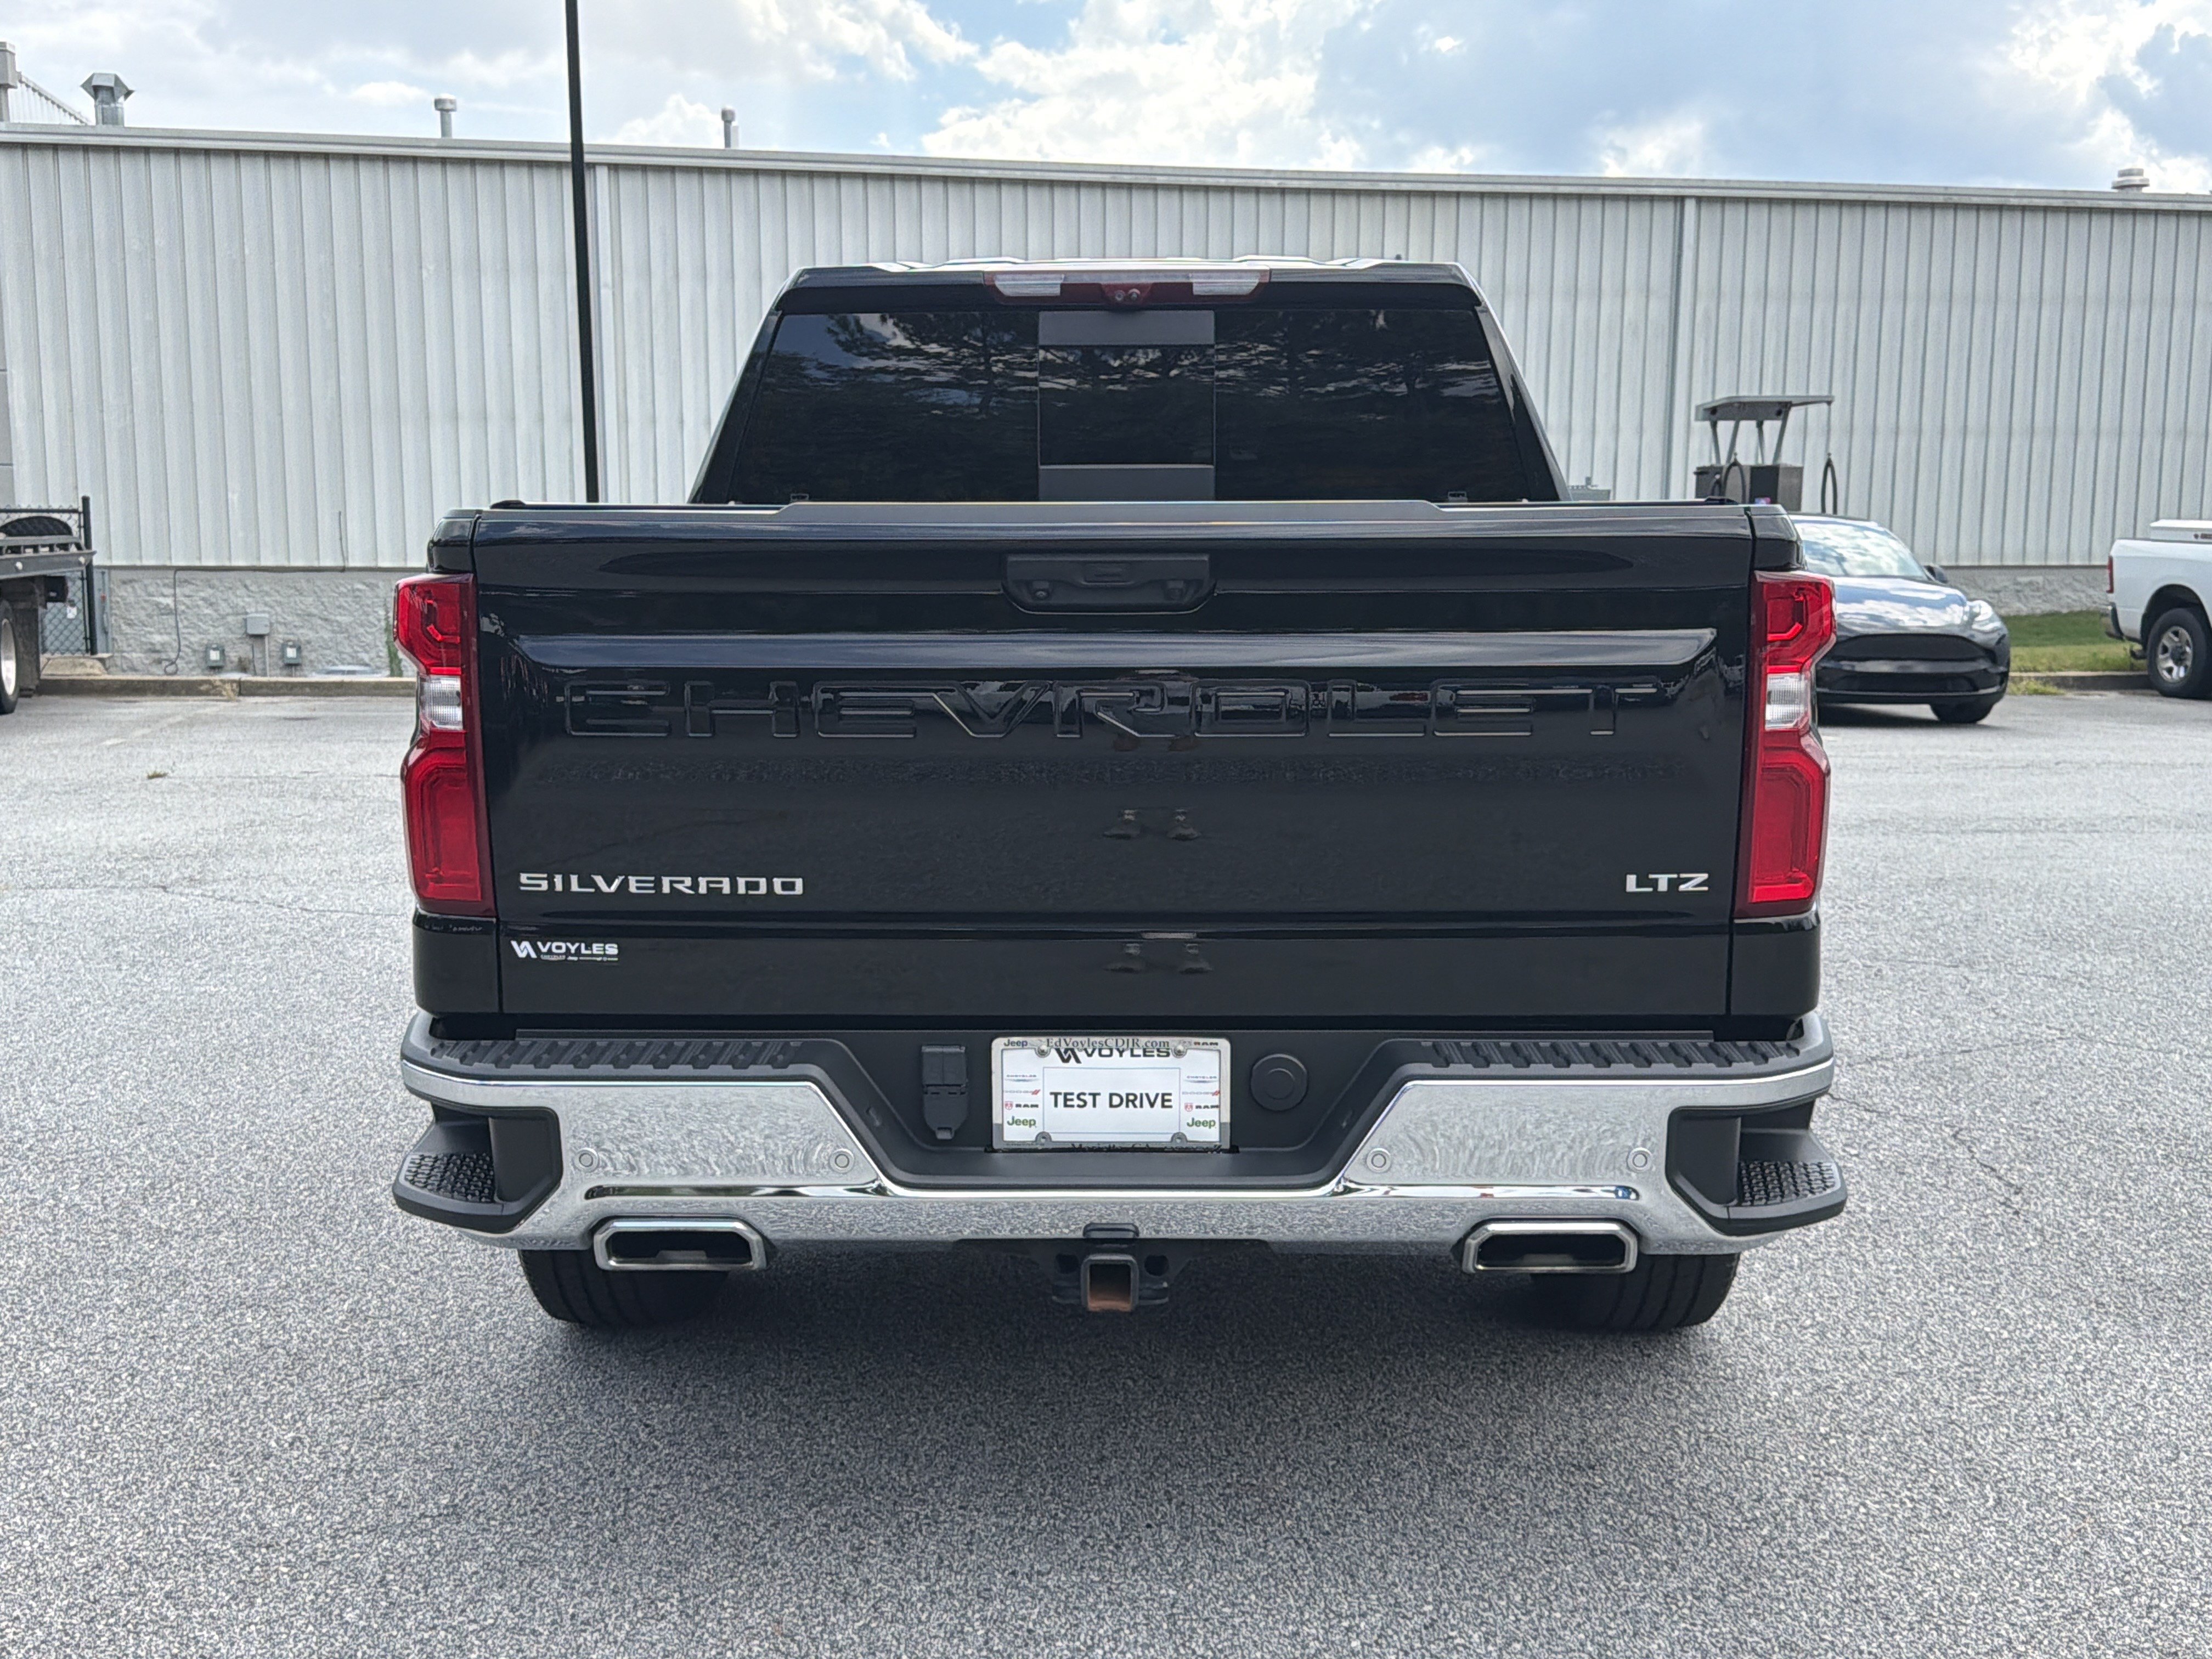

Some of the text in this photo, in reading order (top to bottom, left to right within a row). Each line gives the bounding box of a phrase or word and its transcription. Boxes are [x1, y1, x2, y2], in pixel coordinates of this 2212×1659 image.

[565, 677, 1658, 738] CHEVROLET
[520, 873, 803, 895] SILVERADO
[1626, 873, 1709, 893] LTZ
[537, 941, 619, 955] VOYLES
[1003, 1039, 1028, 1048] Jeep
[1046, 1037, 1170, 1052] EdVoylesCDJR.com
[1082, 1047, 1171, 1058] VOYLES
[1049, 1091, 1173, 1109] TEST DRIVE
[1006, 1115, 1036, 1128] Jeep
[1186, 1117, 1216, 1129] Jeep
